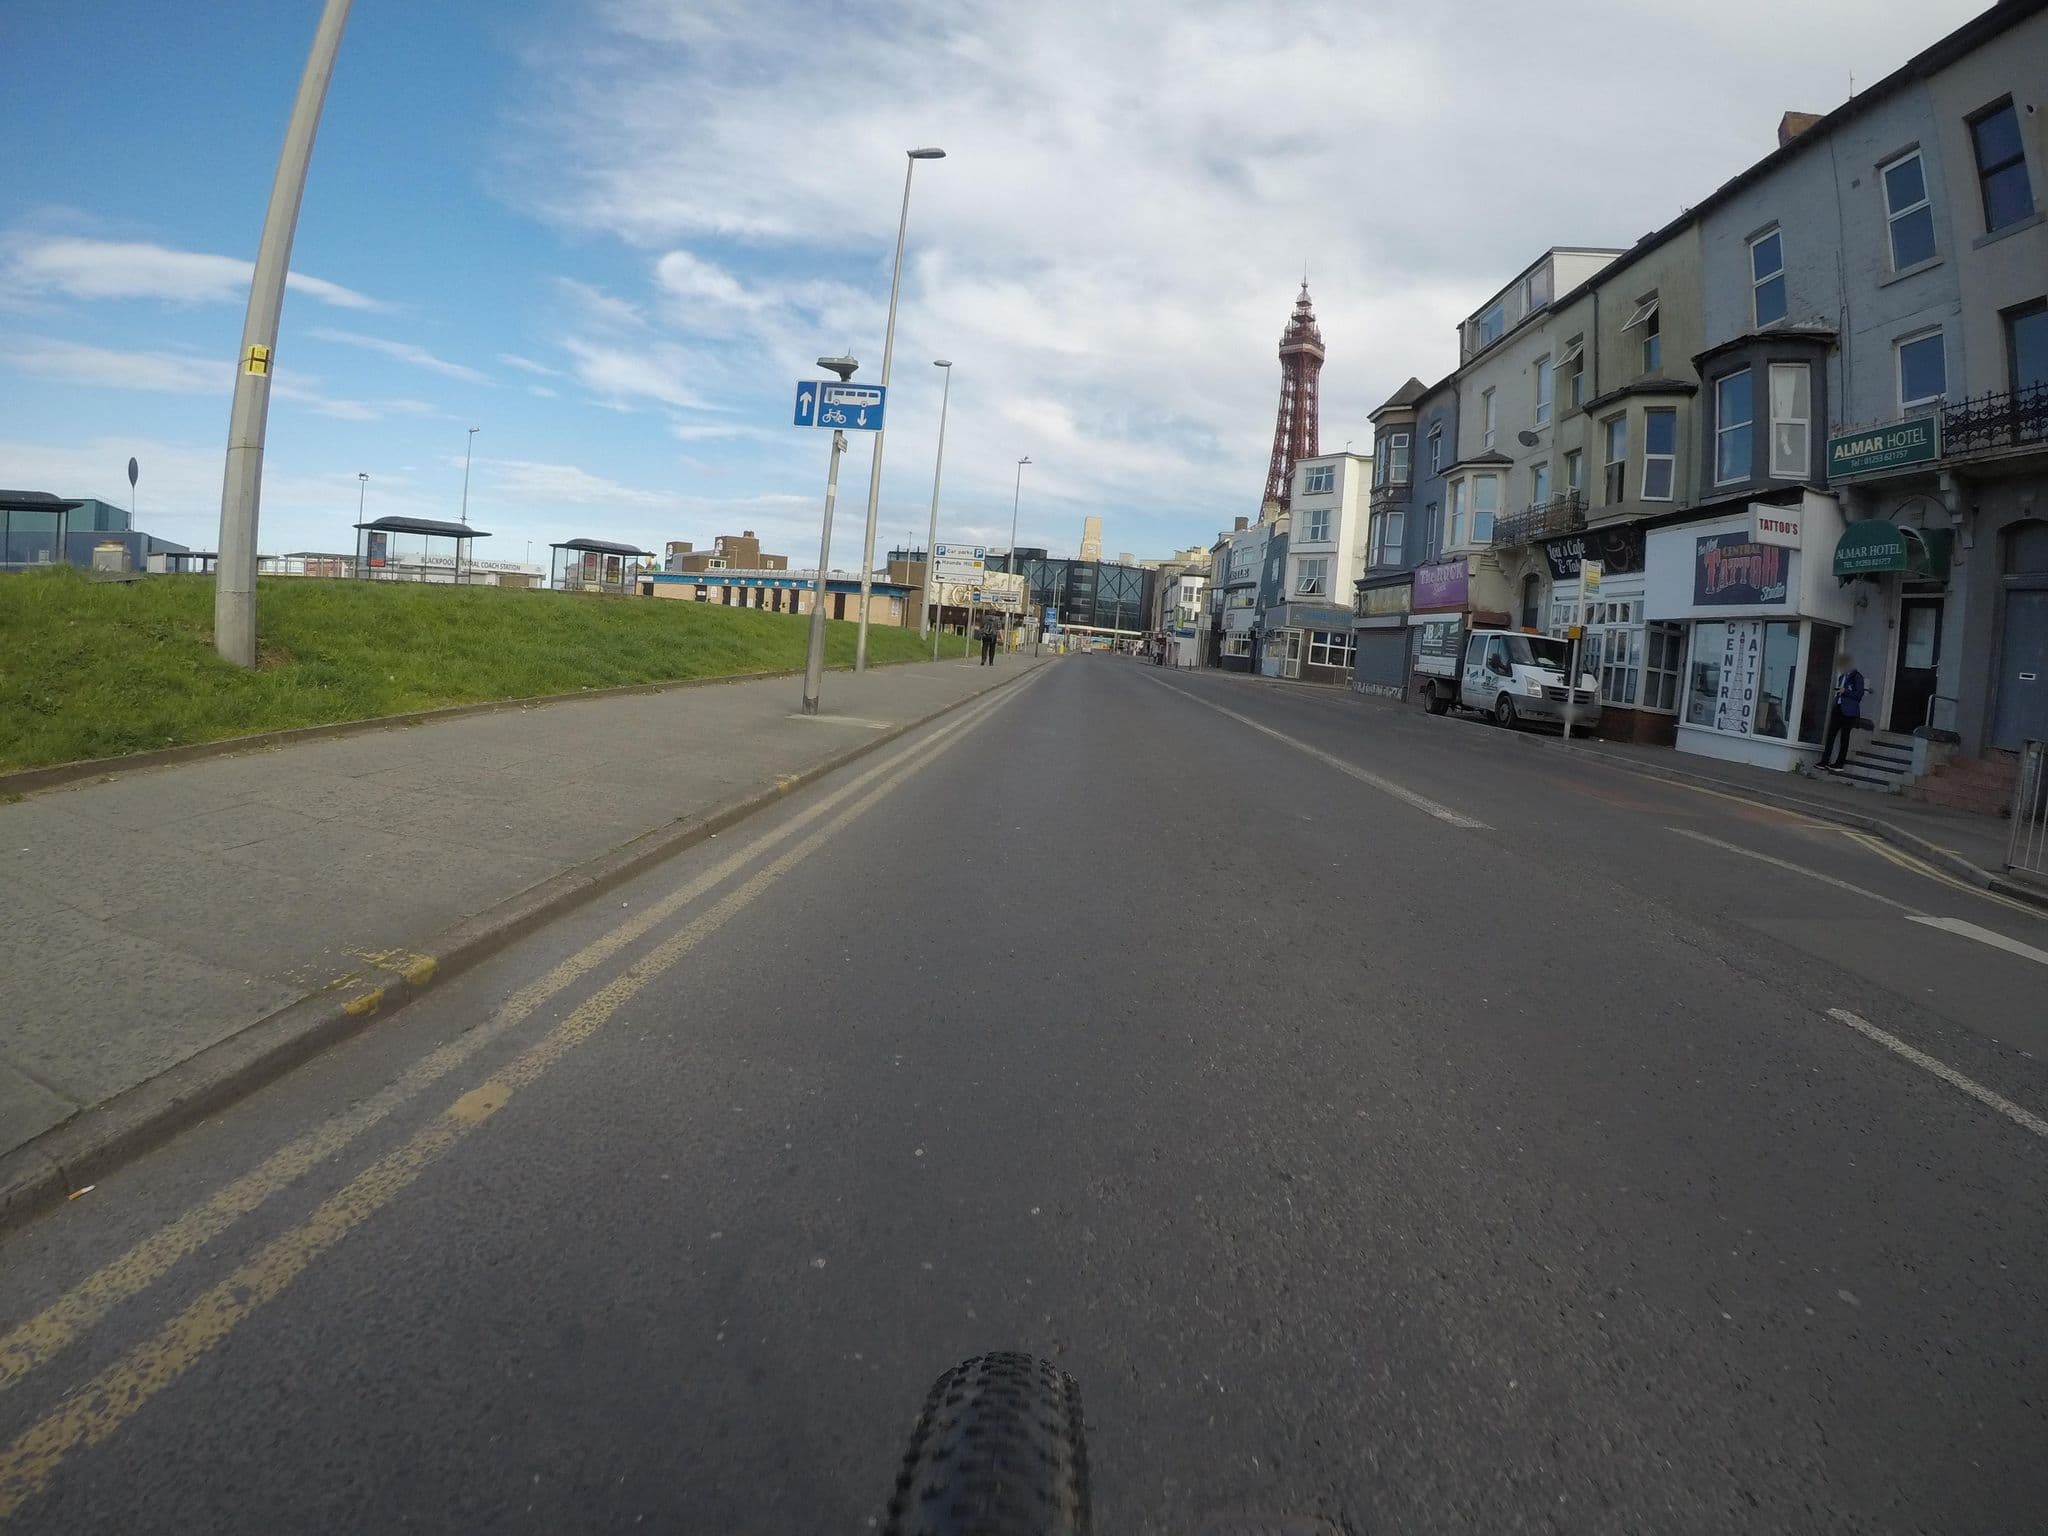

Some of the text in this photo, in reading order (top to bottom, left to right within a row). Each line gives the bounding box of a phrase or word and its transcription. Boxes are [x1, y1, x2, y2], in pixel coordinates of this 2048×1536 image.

[250, 347, 269, 373] H
[1834, 427, 1928, 459] ALMAR HOTEL
[1864, 453, 1883, 465] 01253
[1759, 518, 1798, 536] TATTOO'S
[1567, 539, 1586, 559] Cafe
[1720, 543, 1760, 558] CENTRAL
[1836, 544, 1902, 560] ALMAR HOTEL
[421, 557, 455, 566] BLACKPOOL
[481, 561, 500, 570] COACH
[500, 563, 521, 571] STATION
[1717, 622, 1736, 731] CENTRAL
[1740, 622, 1760, 734] TATTOOS
